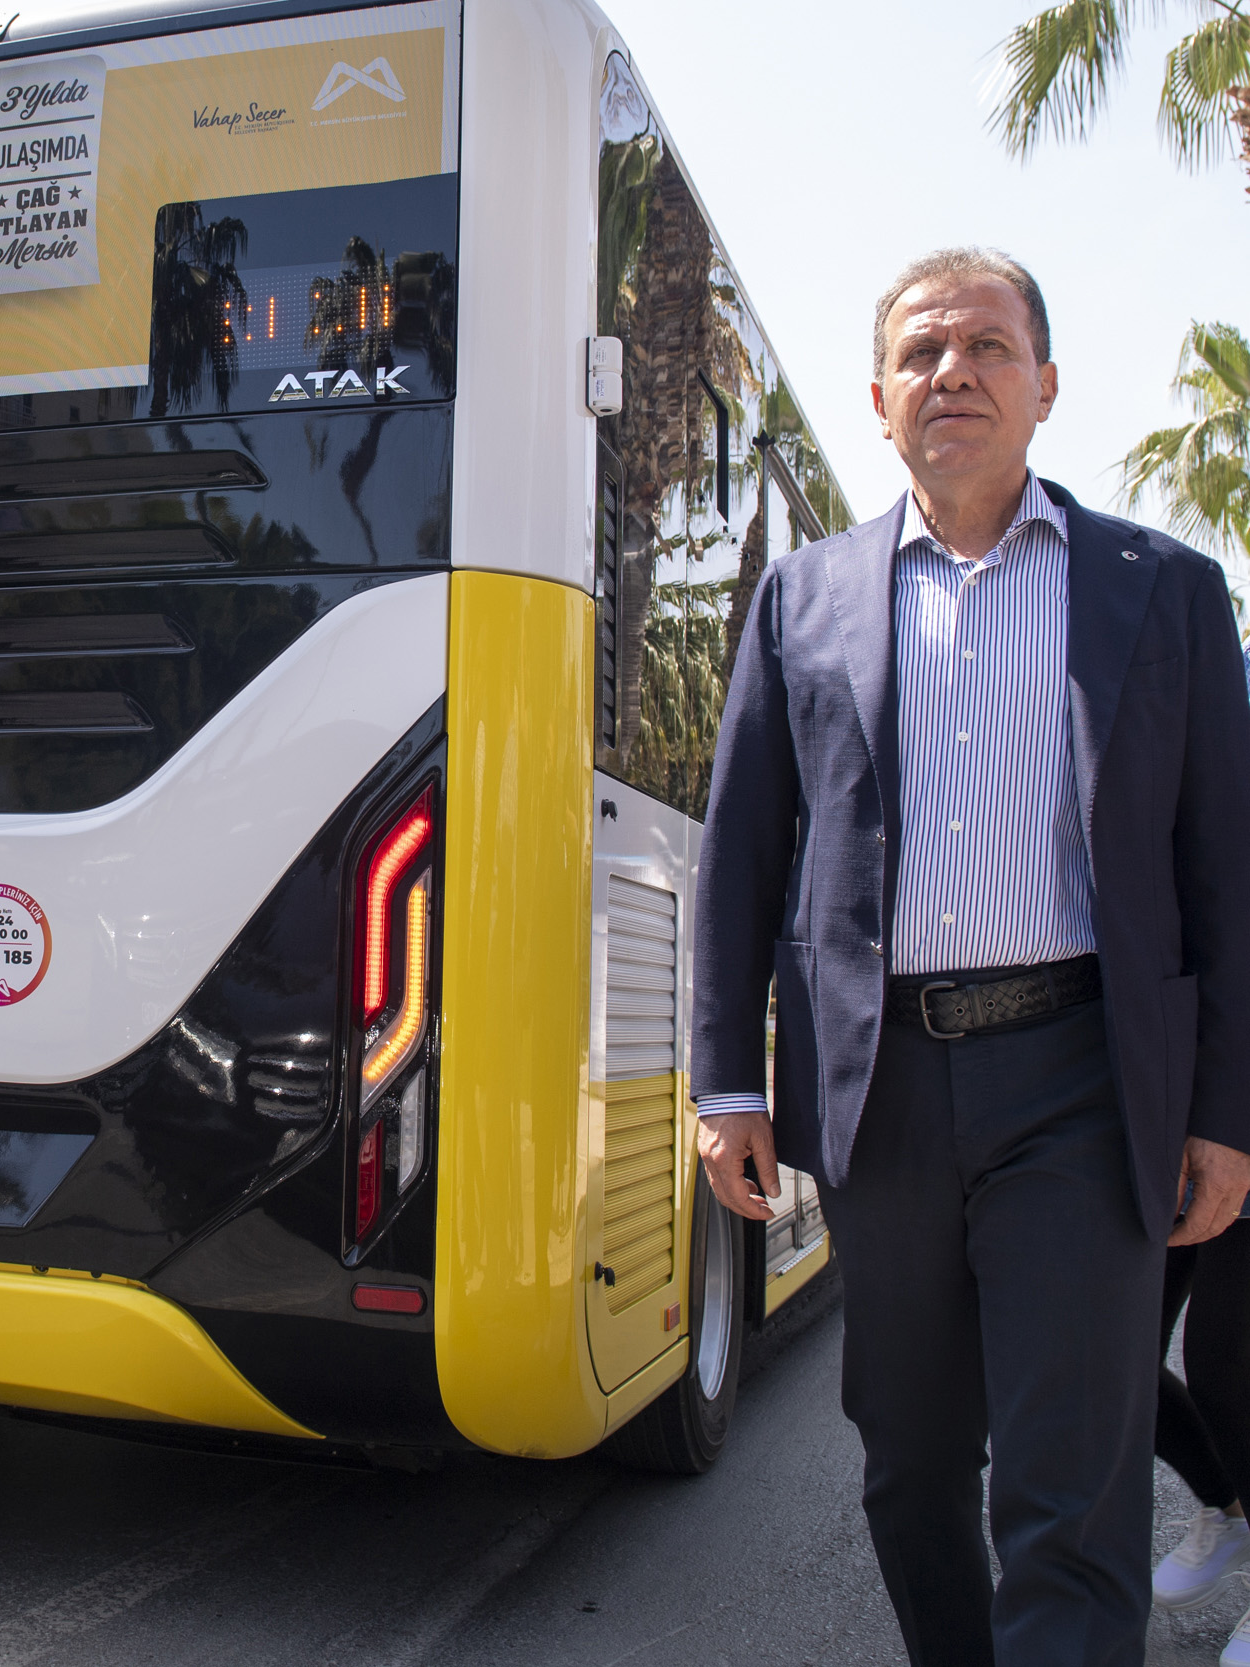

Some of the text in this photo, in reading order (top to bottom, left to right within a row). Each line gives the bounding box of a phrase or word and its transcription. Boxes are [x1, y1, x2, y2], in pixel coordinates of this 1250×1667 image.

[0, 78, 89, 120] 3 Yılda
[193, 105, 242, 134] Vahap
[16, 180, 61, 215] ÇAĞ
[268, 365, 411, 402] ATAK
[28, 901, 43, 920] İÇİN
[11, 929, 28, 940] 00
[3, 950, 33, 965] 185
